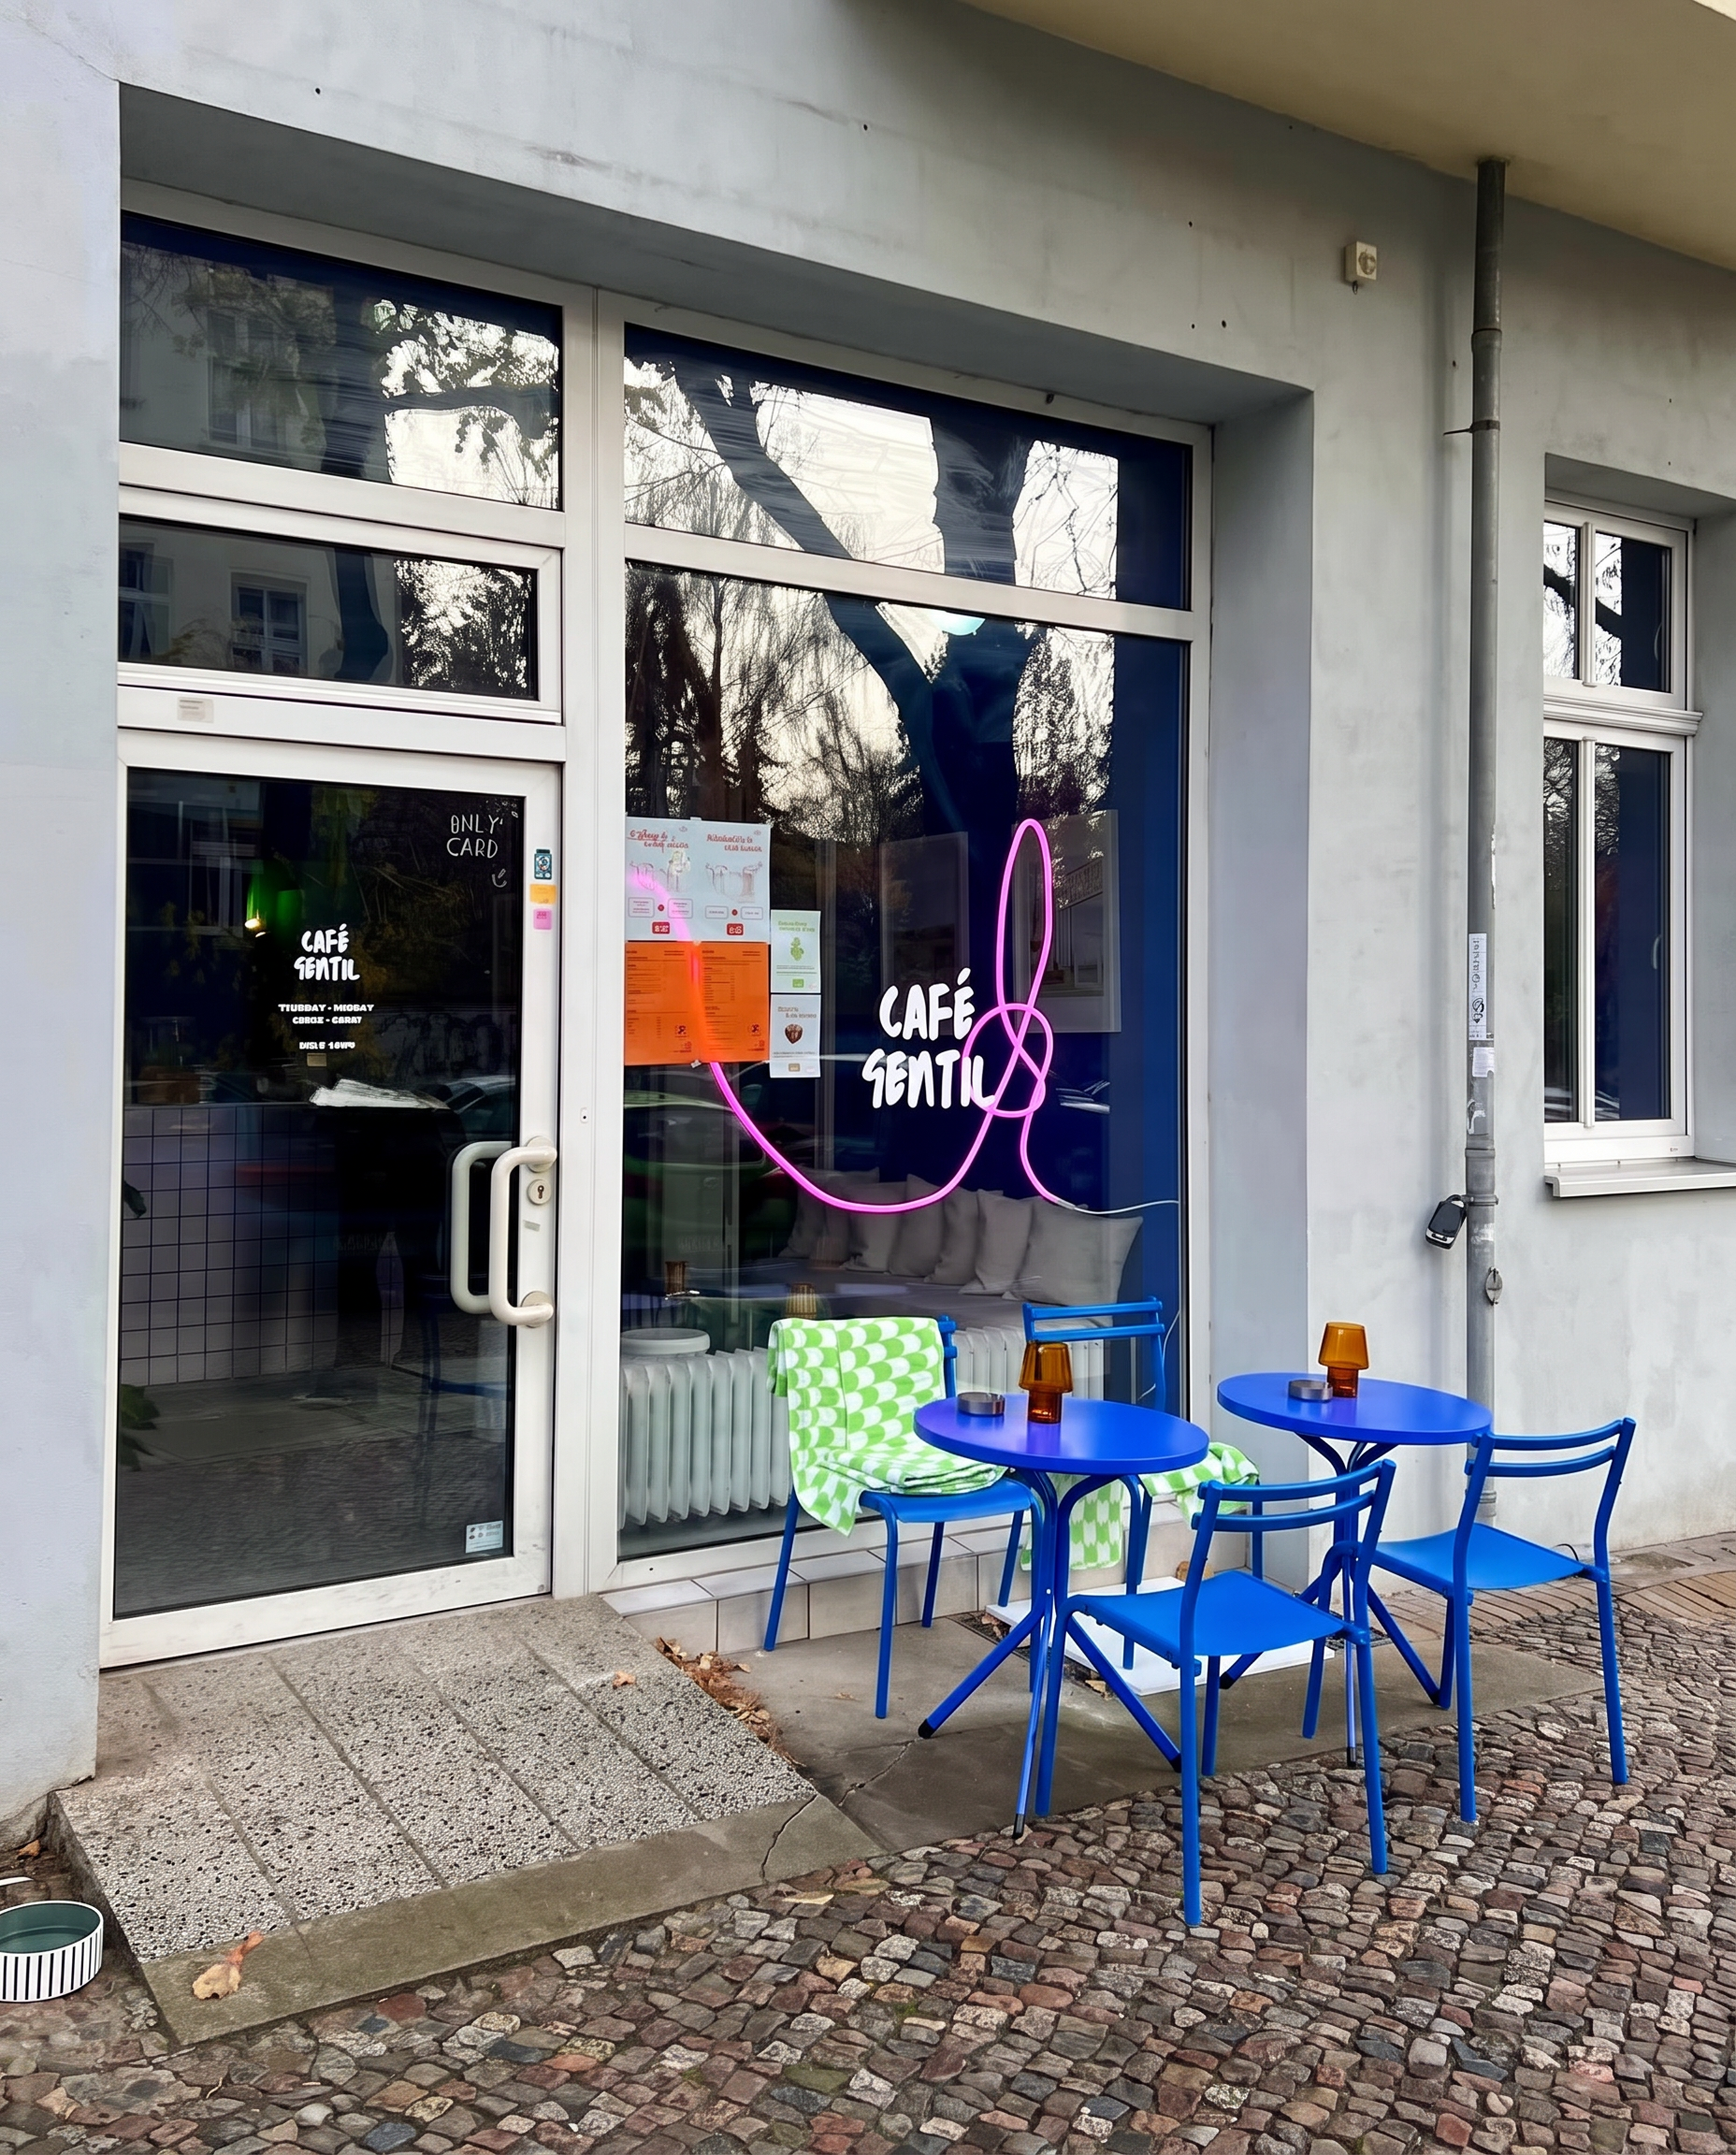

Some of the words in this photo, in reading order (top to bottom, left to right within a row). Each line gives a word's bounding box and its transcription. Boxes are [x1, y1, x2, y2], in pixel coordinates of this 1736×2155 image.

[450, 814, 499, 834] ONLY
[446, 837, 499, 859] CARD
[300, 923, 350, 954] CAFÉ
[878, 967, 976, 1041] CAFÉ
